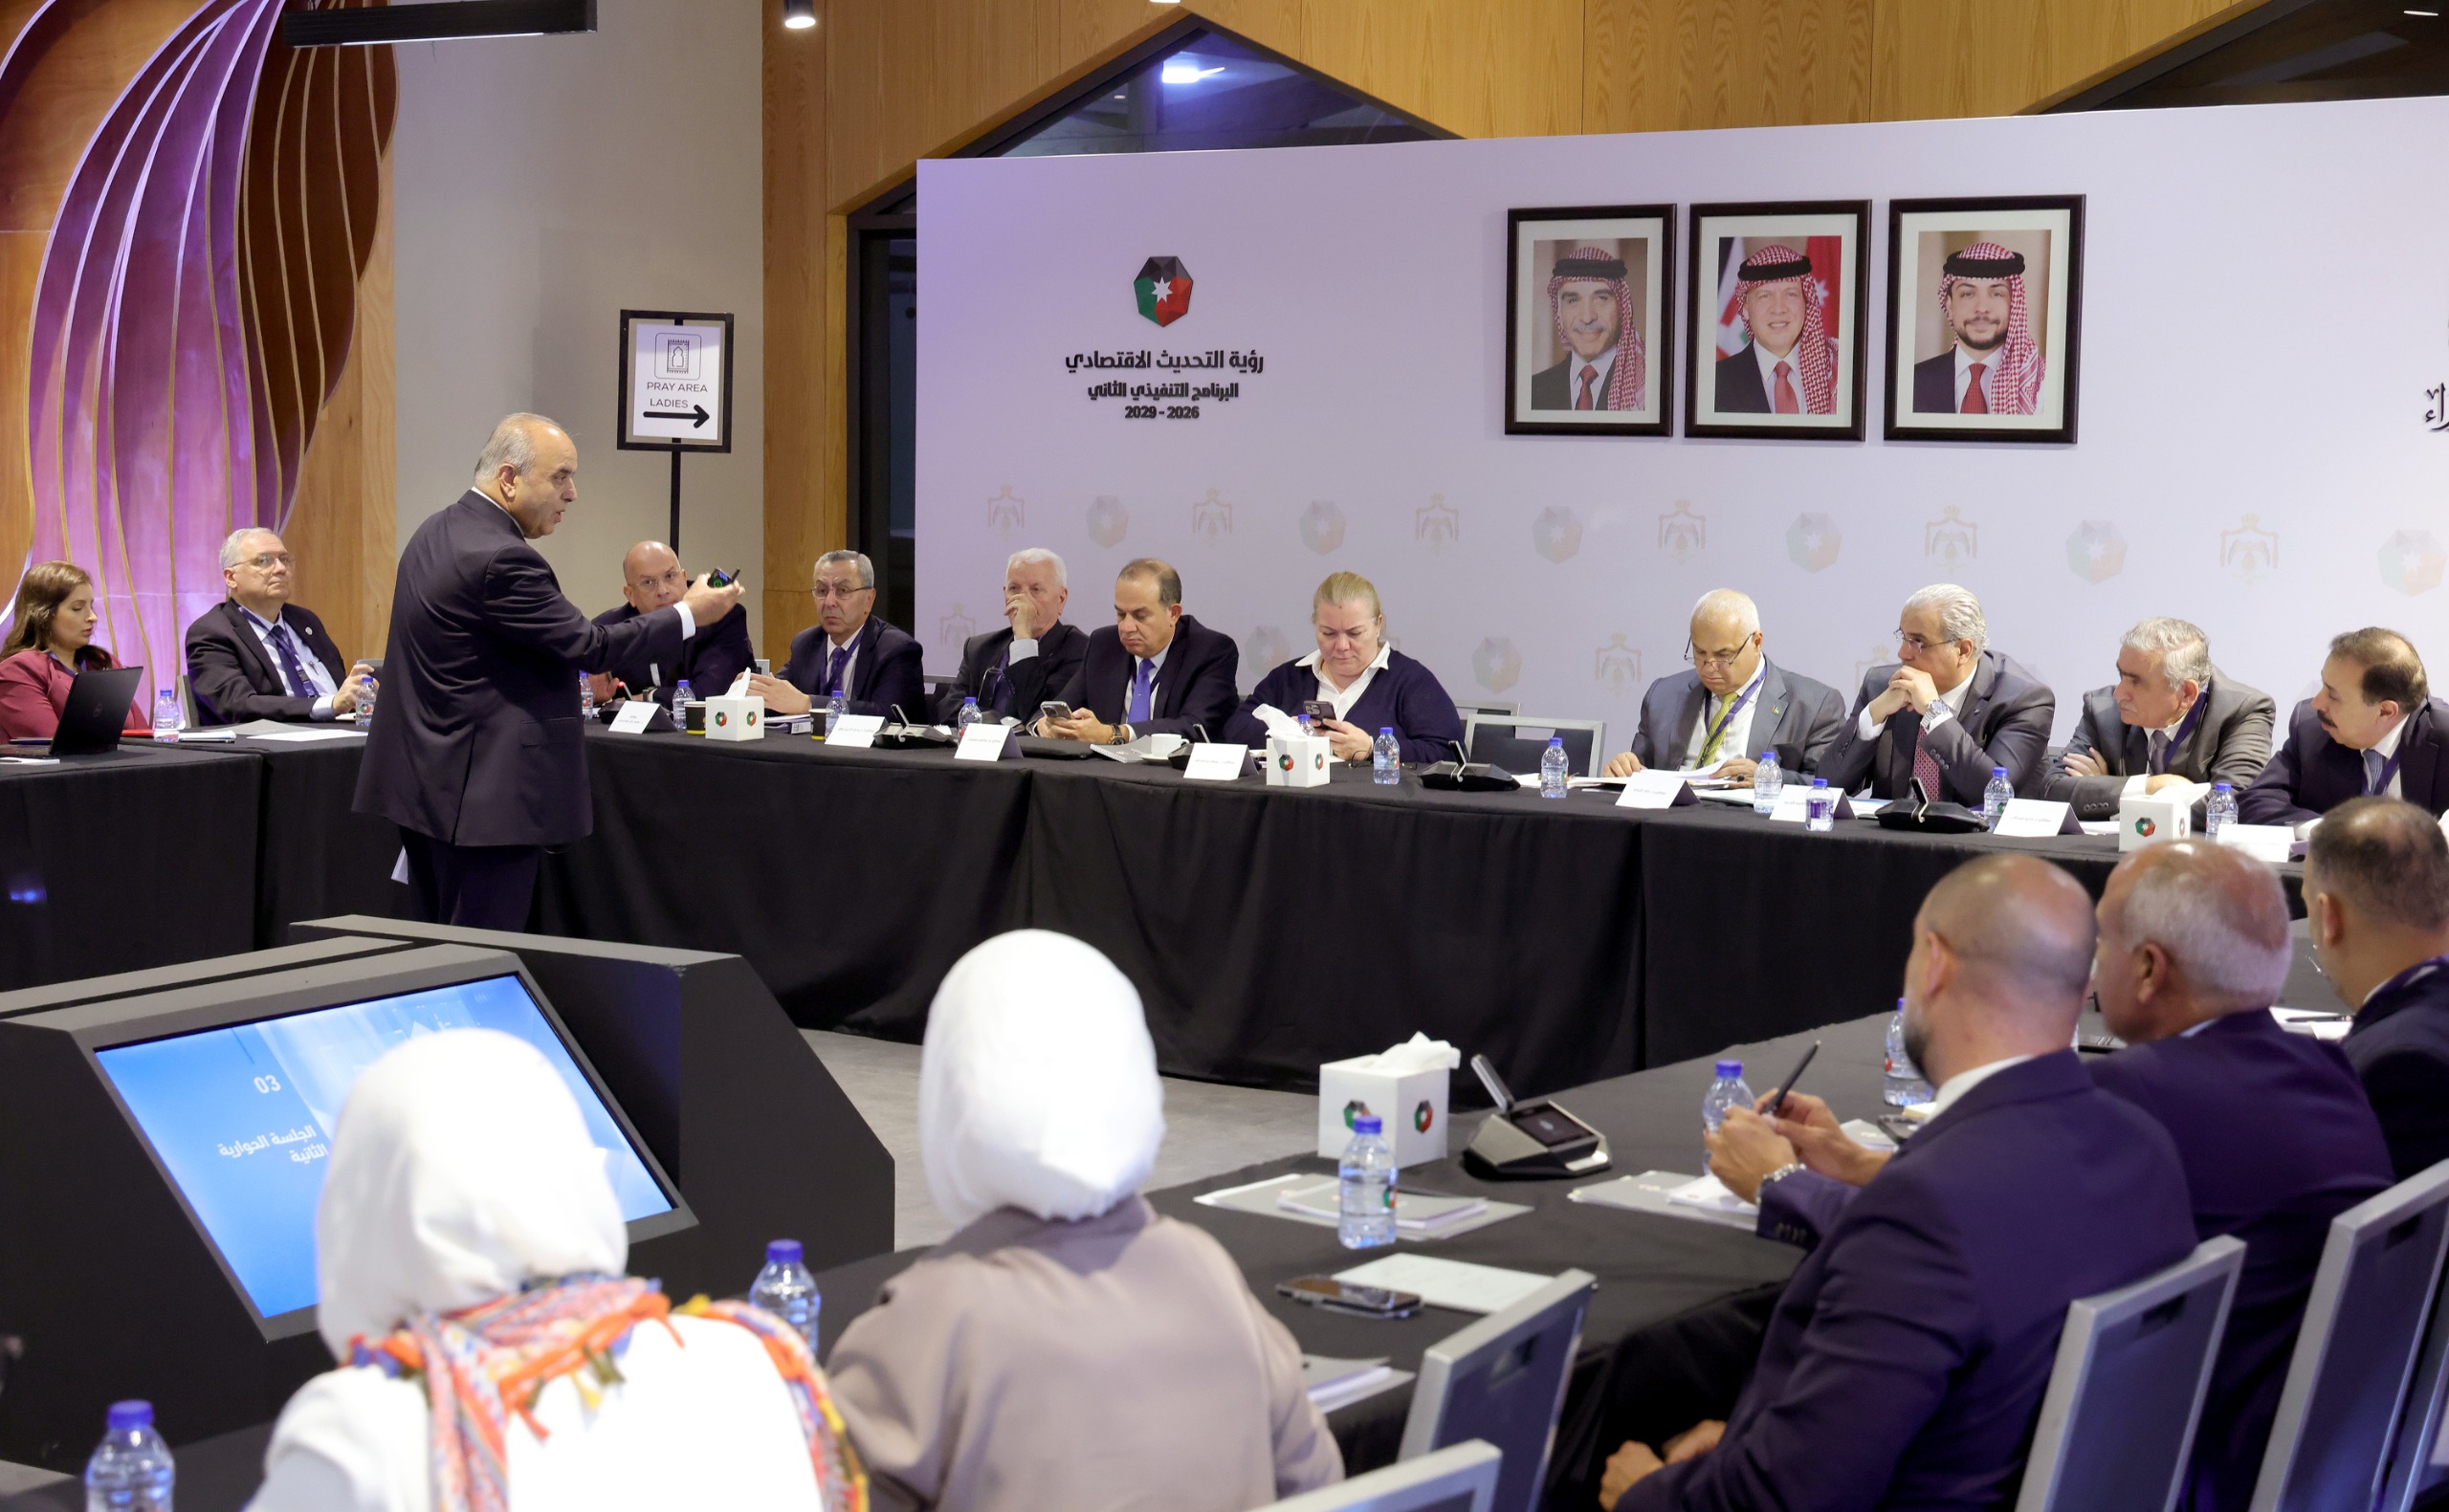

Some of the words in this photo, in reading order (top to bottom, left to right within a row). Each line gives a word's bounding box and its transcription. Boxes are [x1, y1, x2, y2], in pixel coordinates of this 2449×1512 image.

[1065, 350, 1152, 374] الاقتصادي
[1156, 350, 1224, 374] التحديث
[1228, 350, 1265, 374] رؤية
[647, 382, 675, 391] PRAY
[677, 383, 708, 393] AREA
[1088, 380, 1127, 401] الثاني
[1130, 383, 1189, 402] التنفيذي
[1191, 383, 1239, 402] البرنامج
[650, 398, 689, 408] LADIES
[1124, 405, 1158, 419] 2029
[1166, 405, 1200, 419] 2026
[254, 1074, 282, 1094] 03
[270, 1125, 318, 1146] الجلسة
[217, 1134, 270, 1159] الحوارية
[289, 1143, 329, 1164] الثانية
